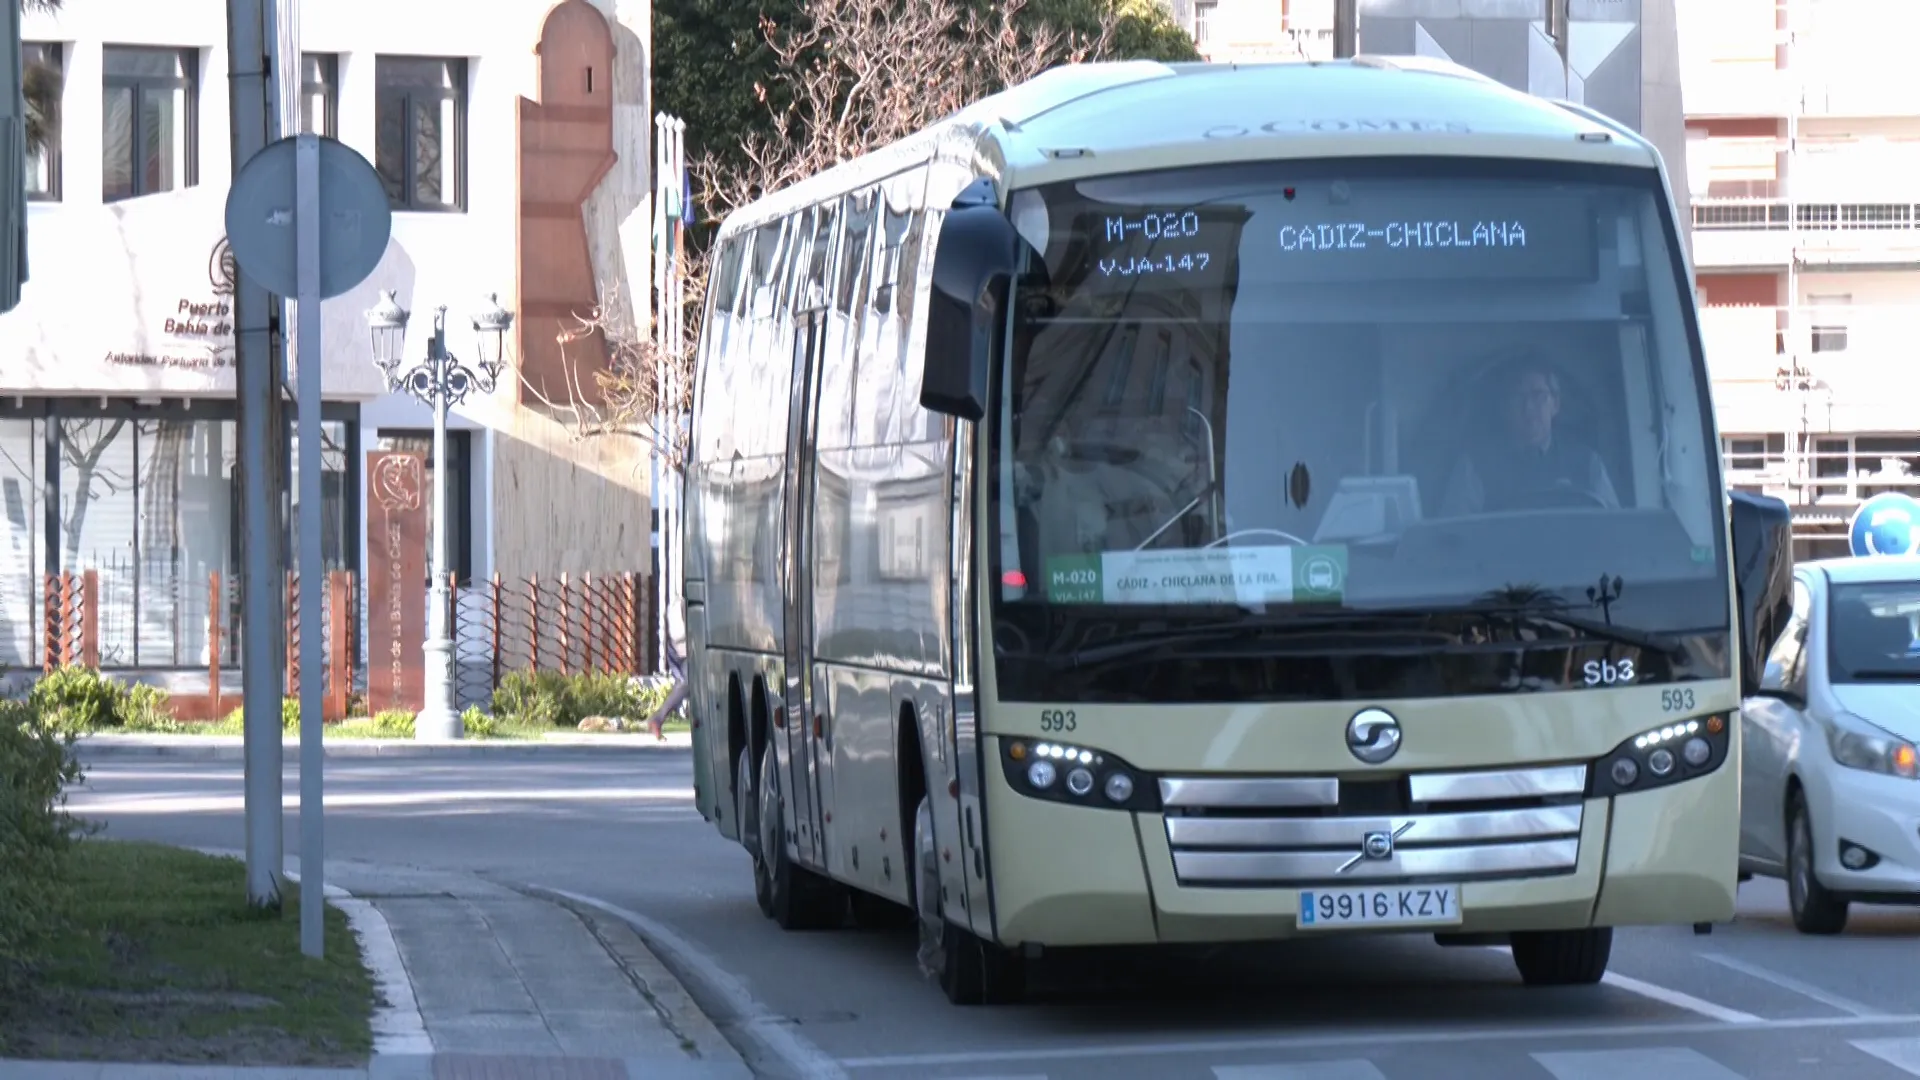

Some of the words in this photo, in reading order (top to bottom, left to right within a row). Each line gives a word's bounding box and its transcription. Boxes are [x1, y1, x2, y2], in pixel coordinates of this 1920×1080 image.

[1106, 211, 1199, 242] M-020
[1279, 221, 1526, 250] CADIZ-CHICLANA
[1099, 252, 1210, 276] VJA-147
[178, 298, 229, 316] Puerto
[213, 320, 231, 336] de
[1053, 569, 1096, 586] M-020
[1161, 574, 1217, 588] CHICLANA
[1220, 573, 1236, 586] DE
[1239, 573, 1253, 585] LA
[1583, 659, 1635, 685] Sb3
[1661, 688, 1696, 712] 593
[1041, 709, 1077, 732] 593
[1319, 892, 1389, 920] 9916
[1399, 889, 1449, 917] KZY
